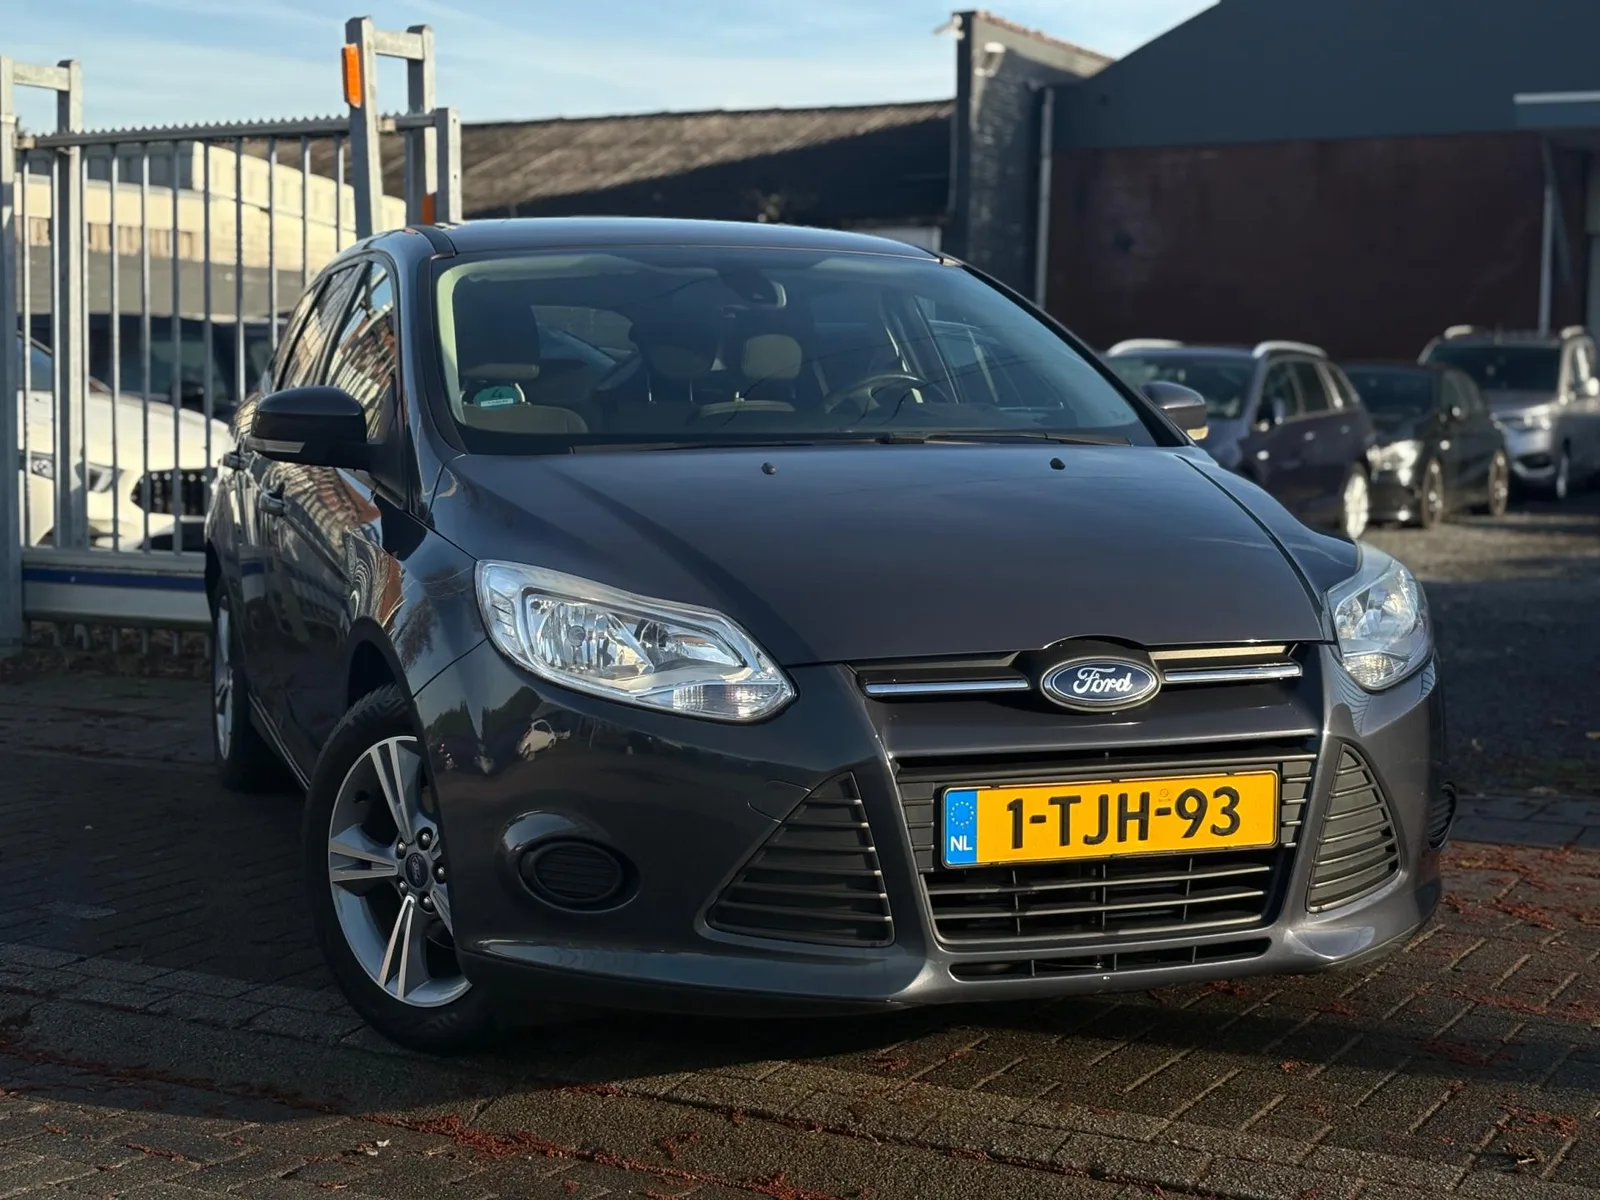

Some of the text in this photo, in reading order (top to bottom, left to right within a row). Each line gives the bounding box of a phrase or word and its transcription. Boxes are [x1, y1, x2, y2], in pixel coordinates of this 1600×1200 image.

[490, 388, 504, 399] 4
[1073, 667, 1134, 694] Ford
[1006, 786, 1241, 849] 1-TJH-93
[950, 834, 973, 851] NL
